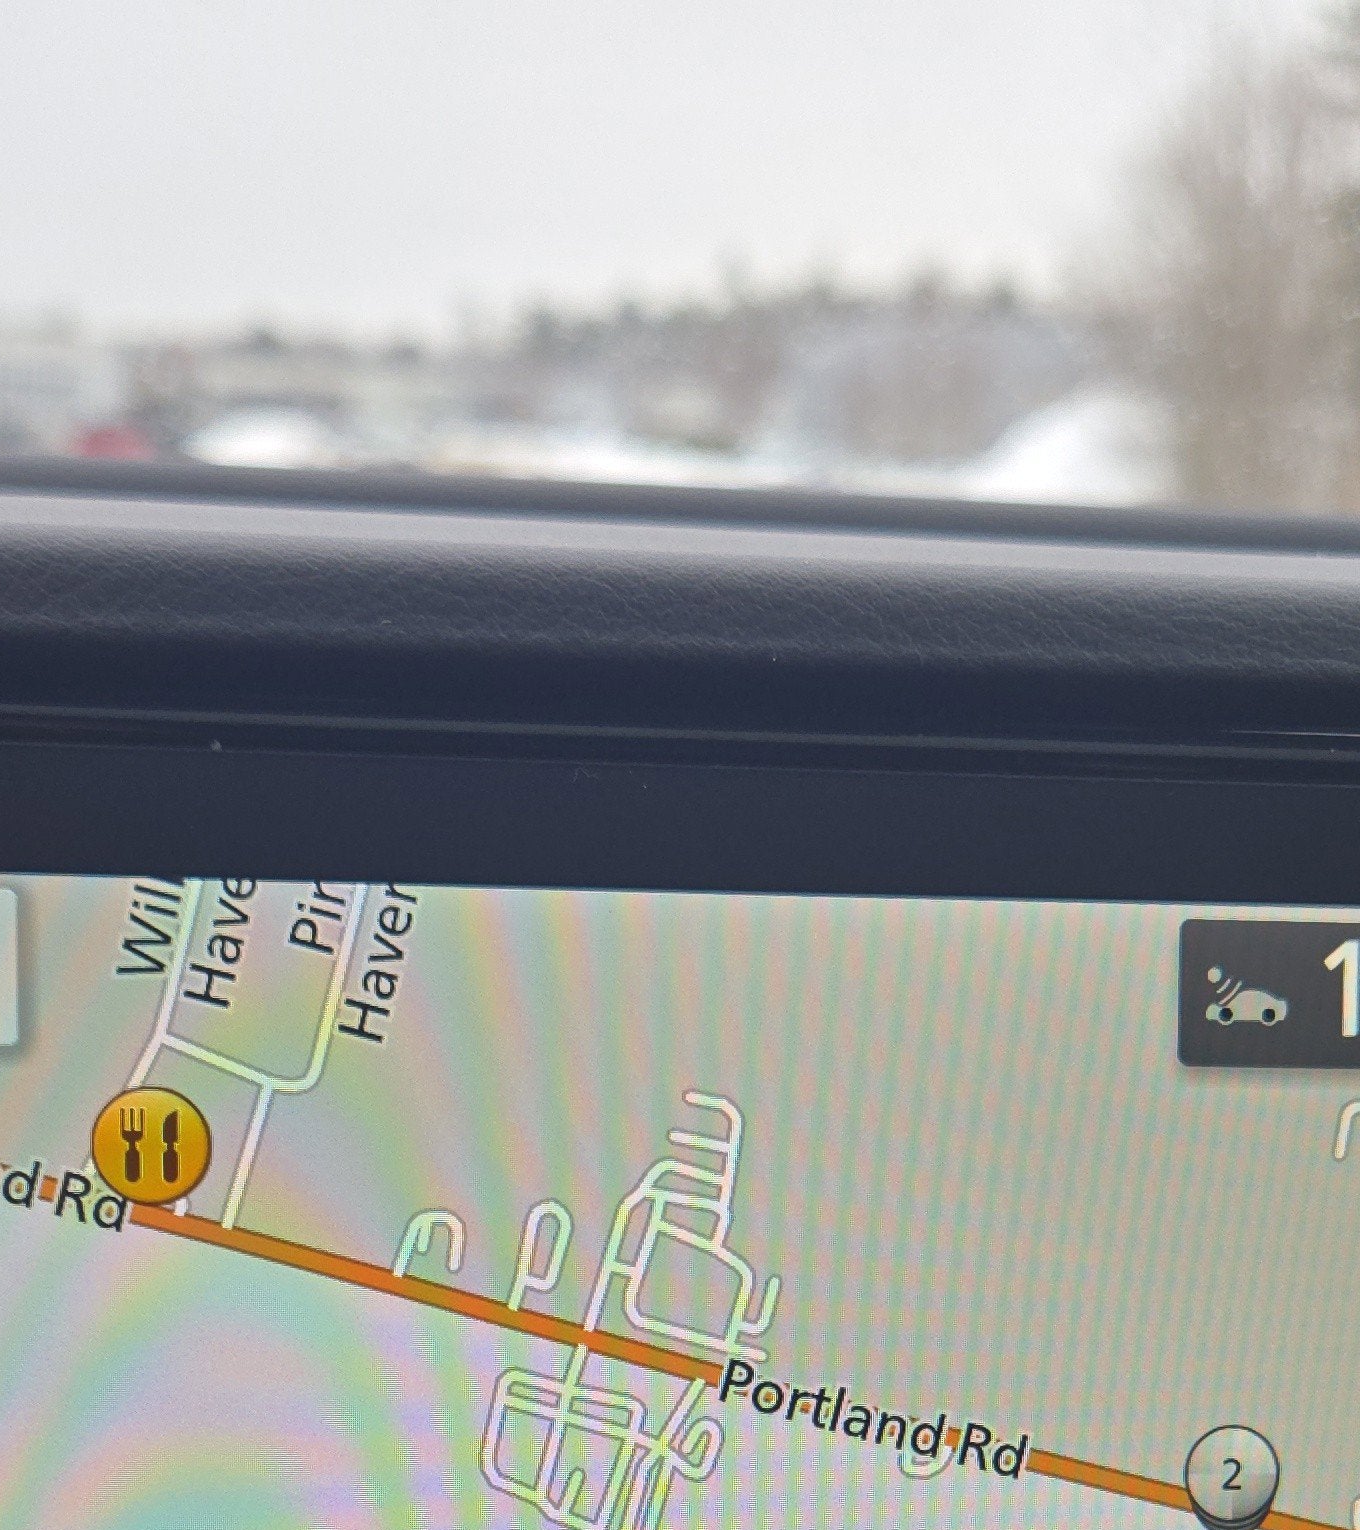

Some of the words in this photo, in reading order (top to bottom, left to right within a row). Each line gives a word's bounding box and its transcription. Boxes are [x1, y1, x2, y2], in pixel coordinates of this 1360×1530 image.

[718, 1357, 948, 1458] Portland
[956, 1421, 1030, 1481] Rd
[1221, 1457, 1243, 1491] 2
